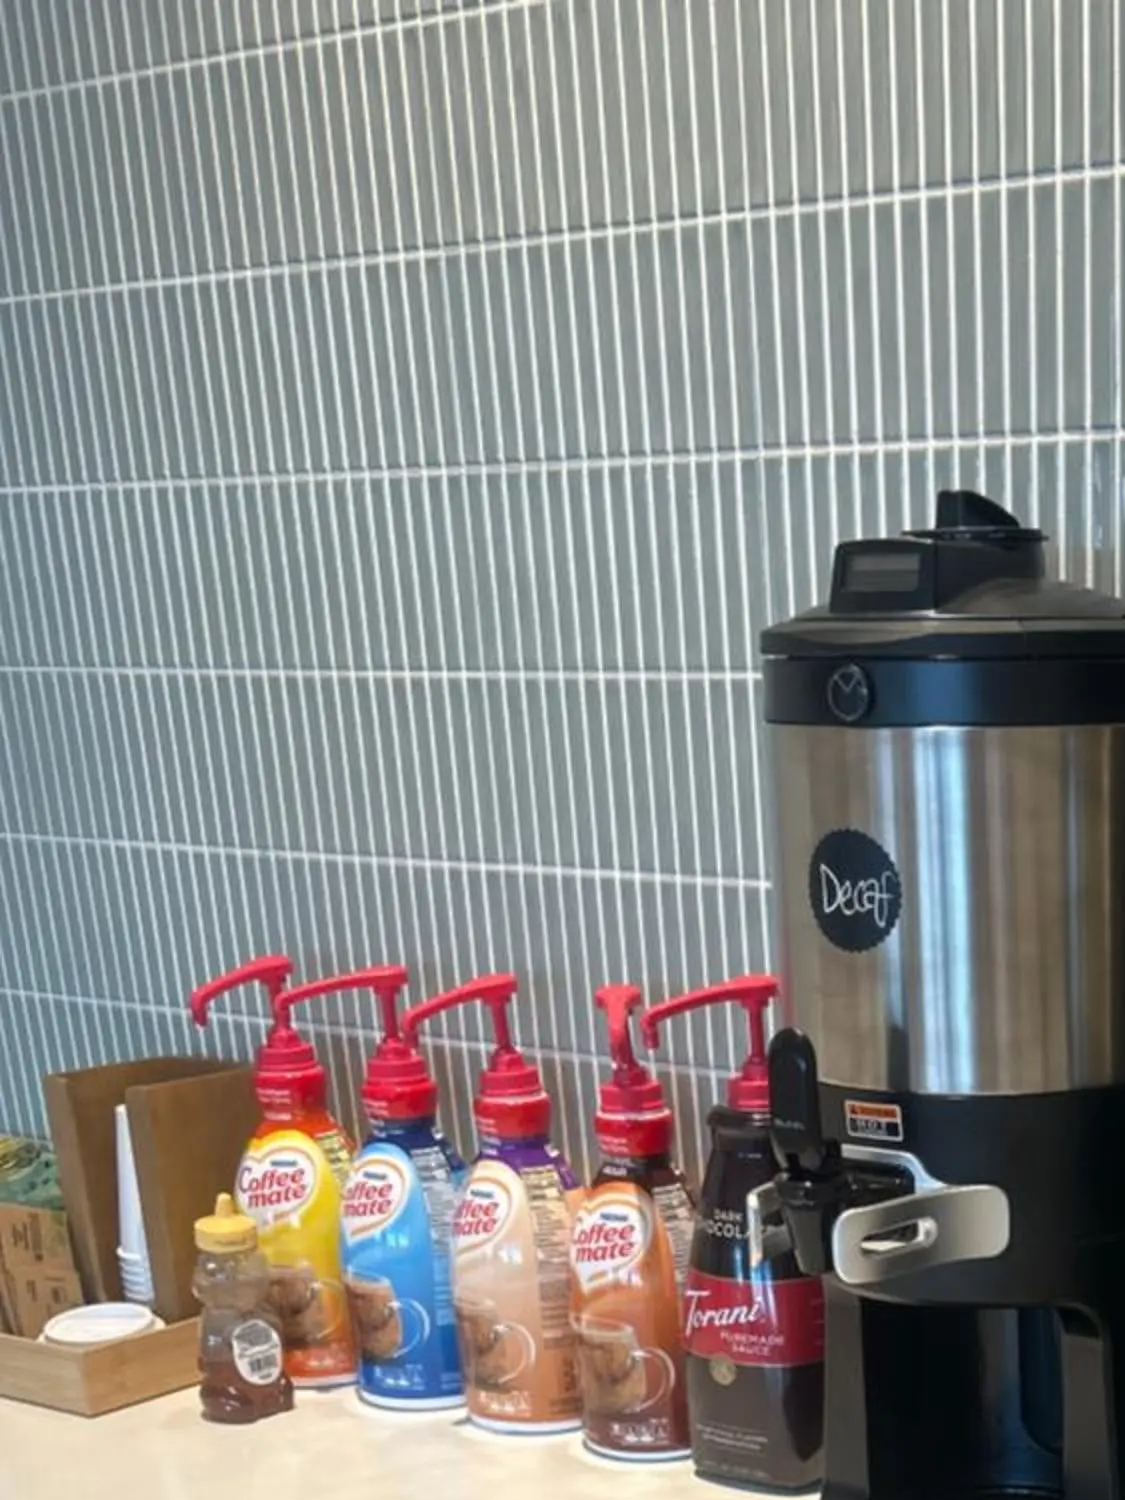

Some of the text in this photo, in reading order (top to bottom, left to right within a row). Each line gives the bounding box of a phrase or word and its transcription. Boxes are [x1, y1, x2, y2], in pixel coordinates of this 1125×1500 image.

[820, 863, 898, 928] Decaf
[238, 1166, 305, 1194] Coffee
[343, 1181, 393, 1200] offee
[248, 1184, 307, 1209] mate
[576, 1242, 635, 1263] mate
[685, 1290, 760, 1337] Torani
